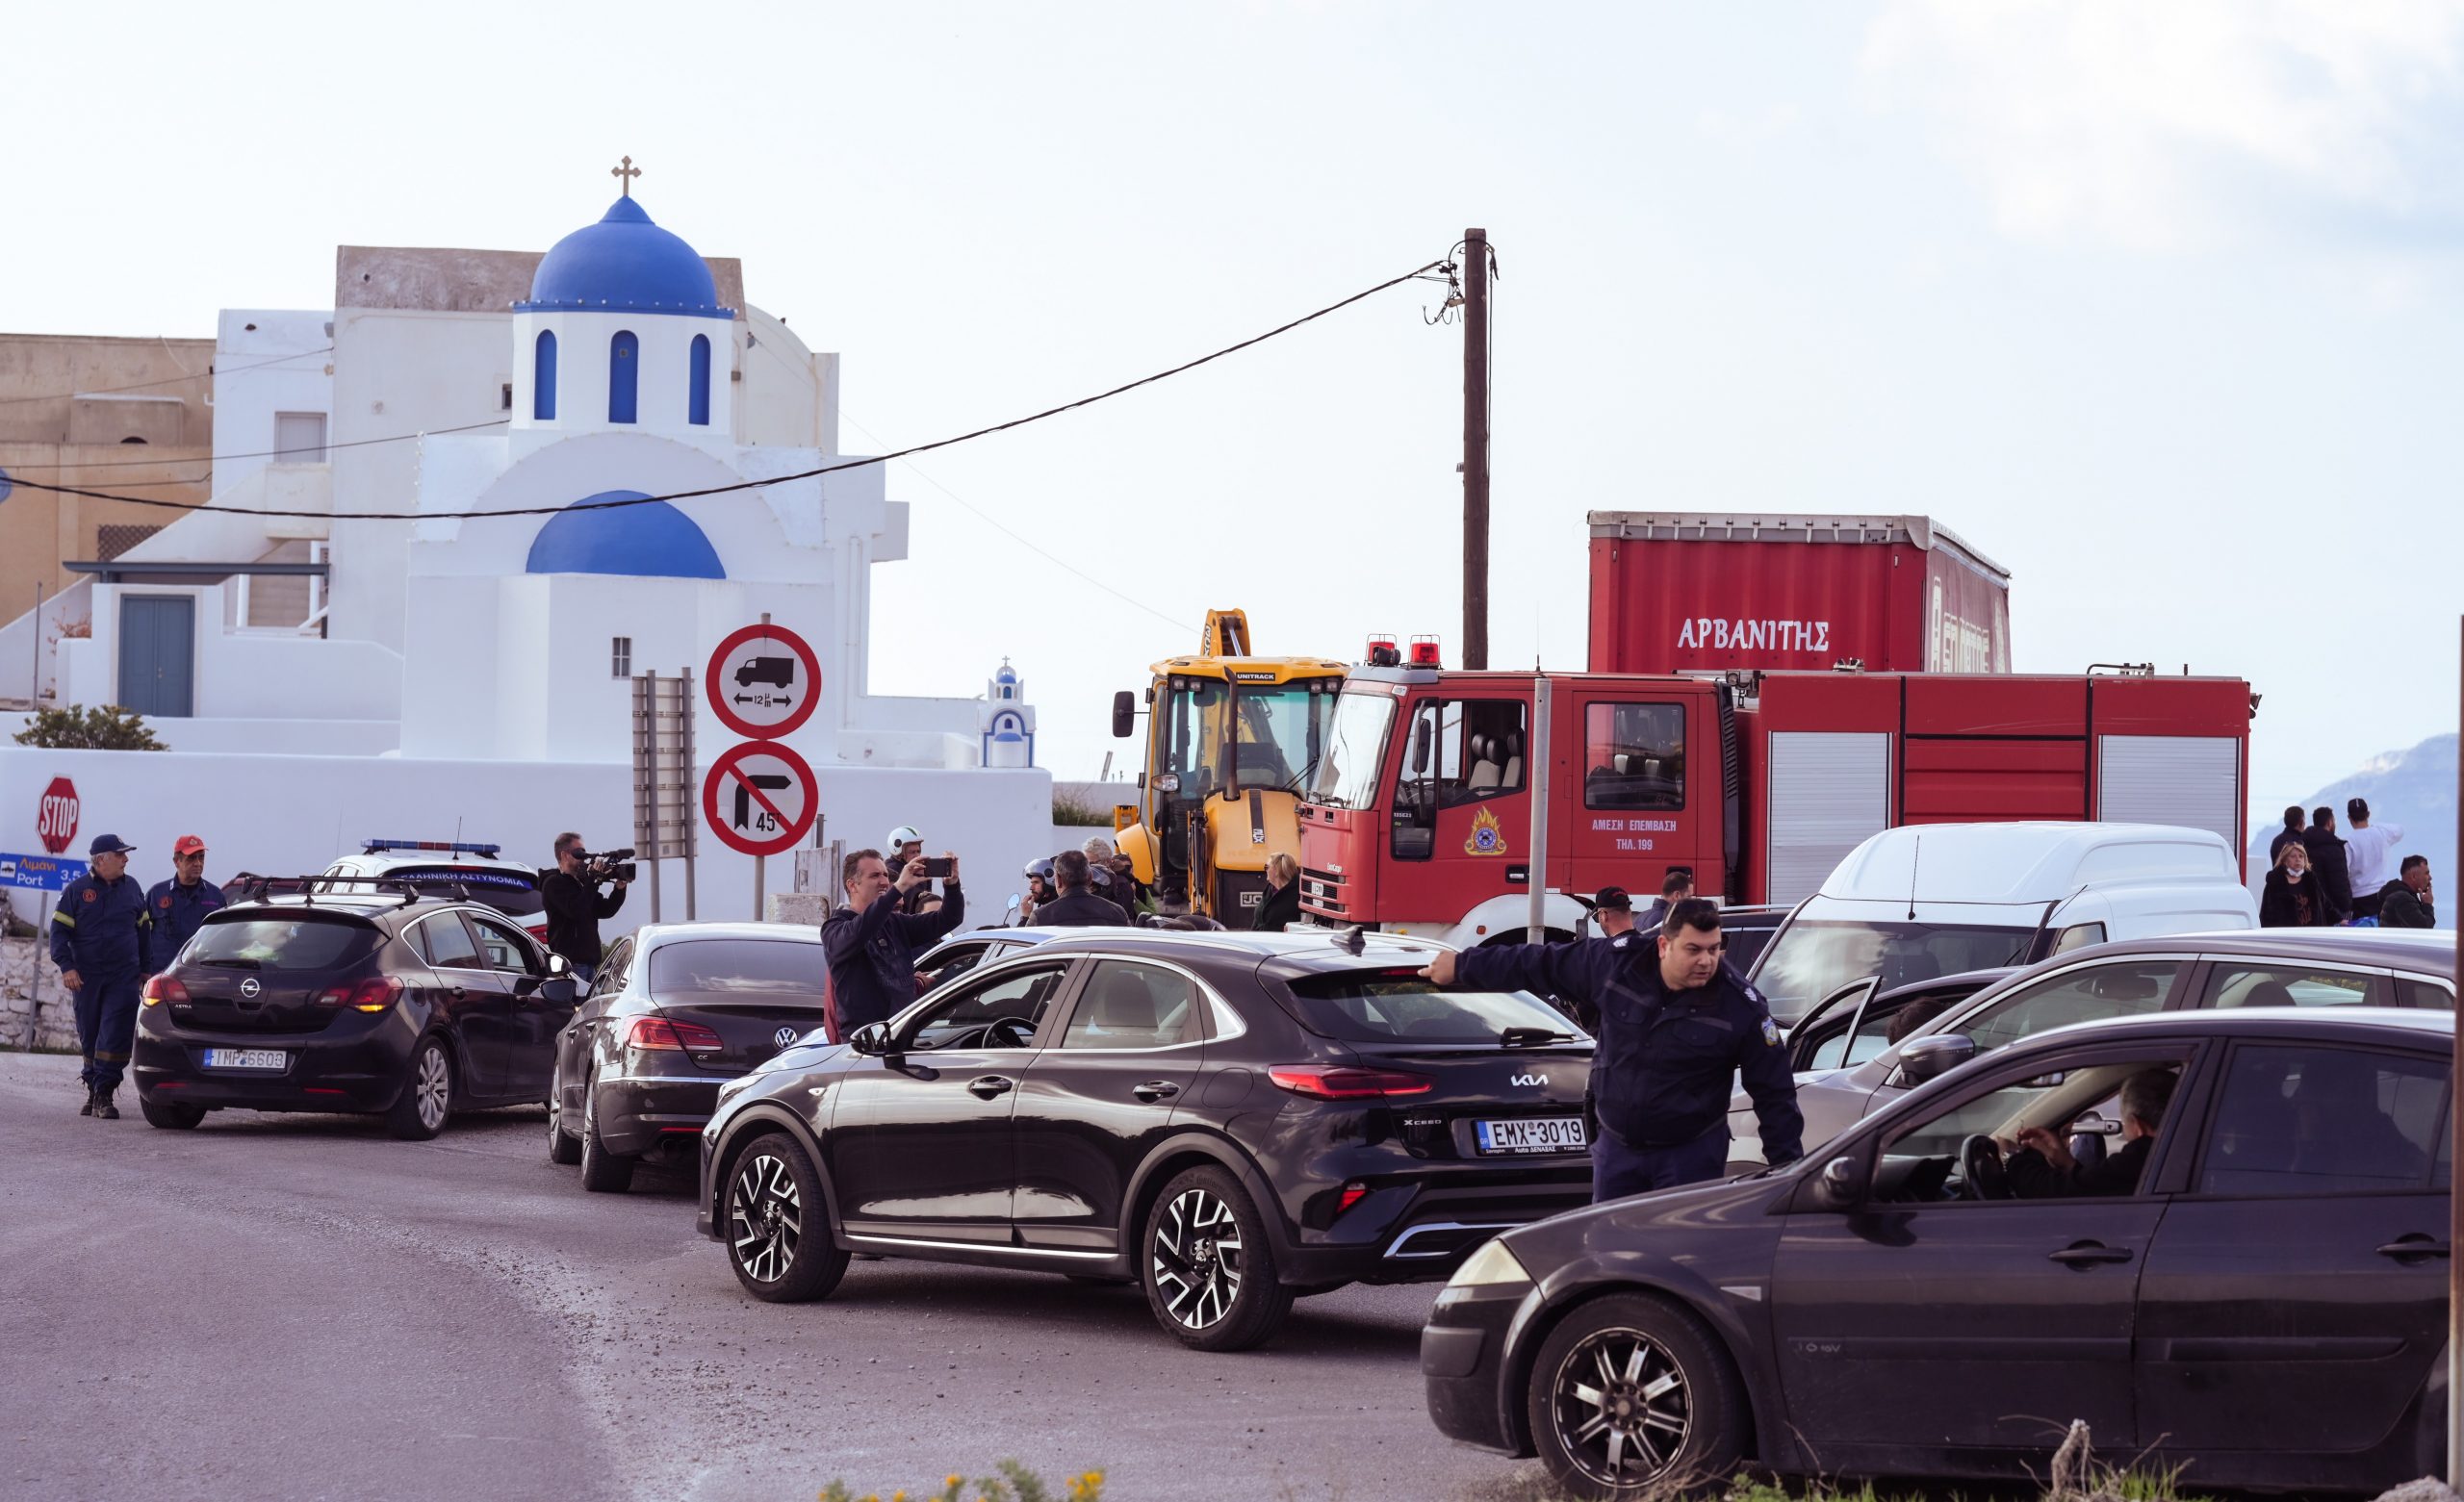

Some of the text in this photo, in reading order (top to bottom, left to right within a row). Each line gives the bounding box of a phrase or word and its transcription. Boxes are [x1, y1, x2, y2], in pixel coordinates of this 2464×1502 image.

[1677, 617, 1830, 652] ΑΡΒΑΝΙΤΗΣ
[754, 695, 763, 704] 12
[40, 795, 78, 838] STOP
[1592, 819, 1677, 831] ΑΜΕΣΗ ΕΠΕΜΒΑΣΗ
[1637, 839, 1654, 851] 199
[20, 857, 56, 871] Λιμάνι
[17, 873, 43, 886] Port
[461, 874, 524, 886] ΑΣΤΥΝΟΜΙΑ
[1510, 1074, 1549, 1086] KIA
